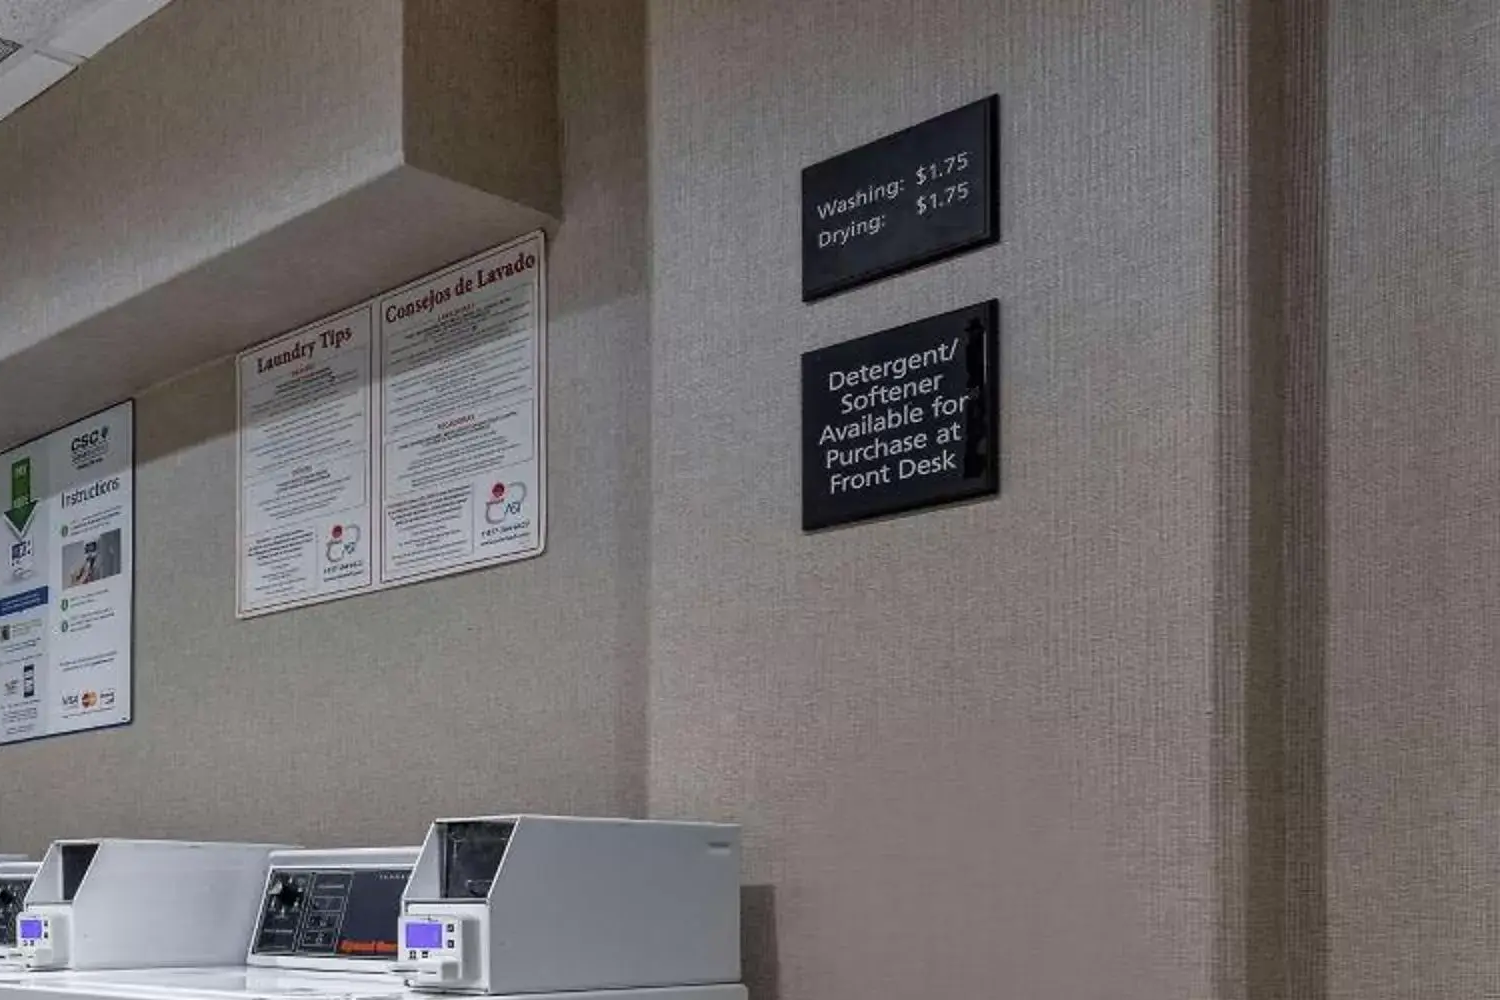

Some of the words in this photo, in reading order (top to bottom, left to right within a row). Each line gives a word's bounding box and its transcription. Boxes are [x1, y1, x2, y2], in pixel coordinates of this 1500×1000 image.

[817, 178, 905, 220] Washing:
[915, 152, 969, 186] $1.75
[818, 214, 886, 248] Drying:
[916, 182, 969, 215] $1.75
[386, 287, 451, 323] Consejos
[455, 276, 473, 297] de
[477, 253, 536, 289] Lavado
[256, 341, 317, 374] Laundry
[319, 328, 353, 349] Tips
[829, 338, 959, 391] Detergent/
[840, 375, 944, 414] Softener
[819, 405, 924, 445] Available
[932, 395, 969, 416] for
[827, 432, 928, 468] Purchase
[937, 422, 962, 442] at
[61, 477, 120, 510] Instructions
[830, 464, 891, 494] Front
[899, 451, 956, 480] Desk
